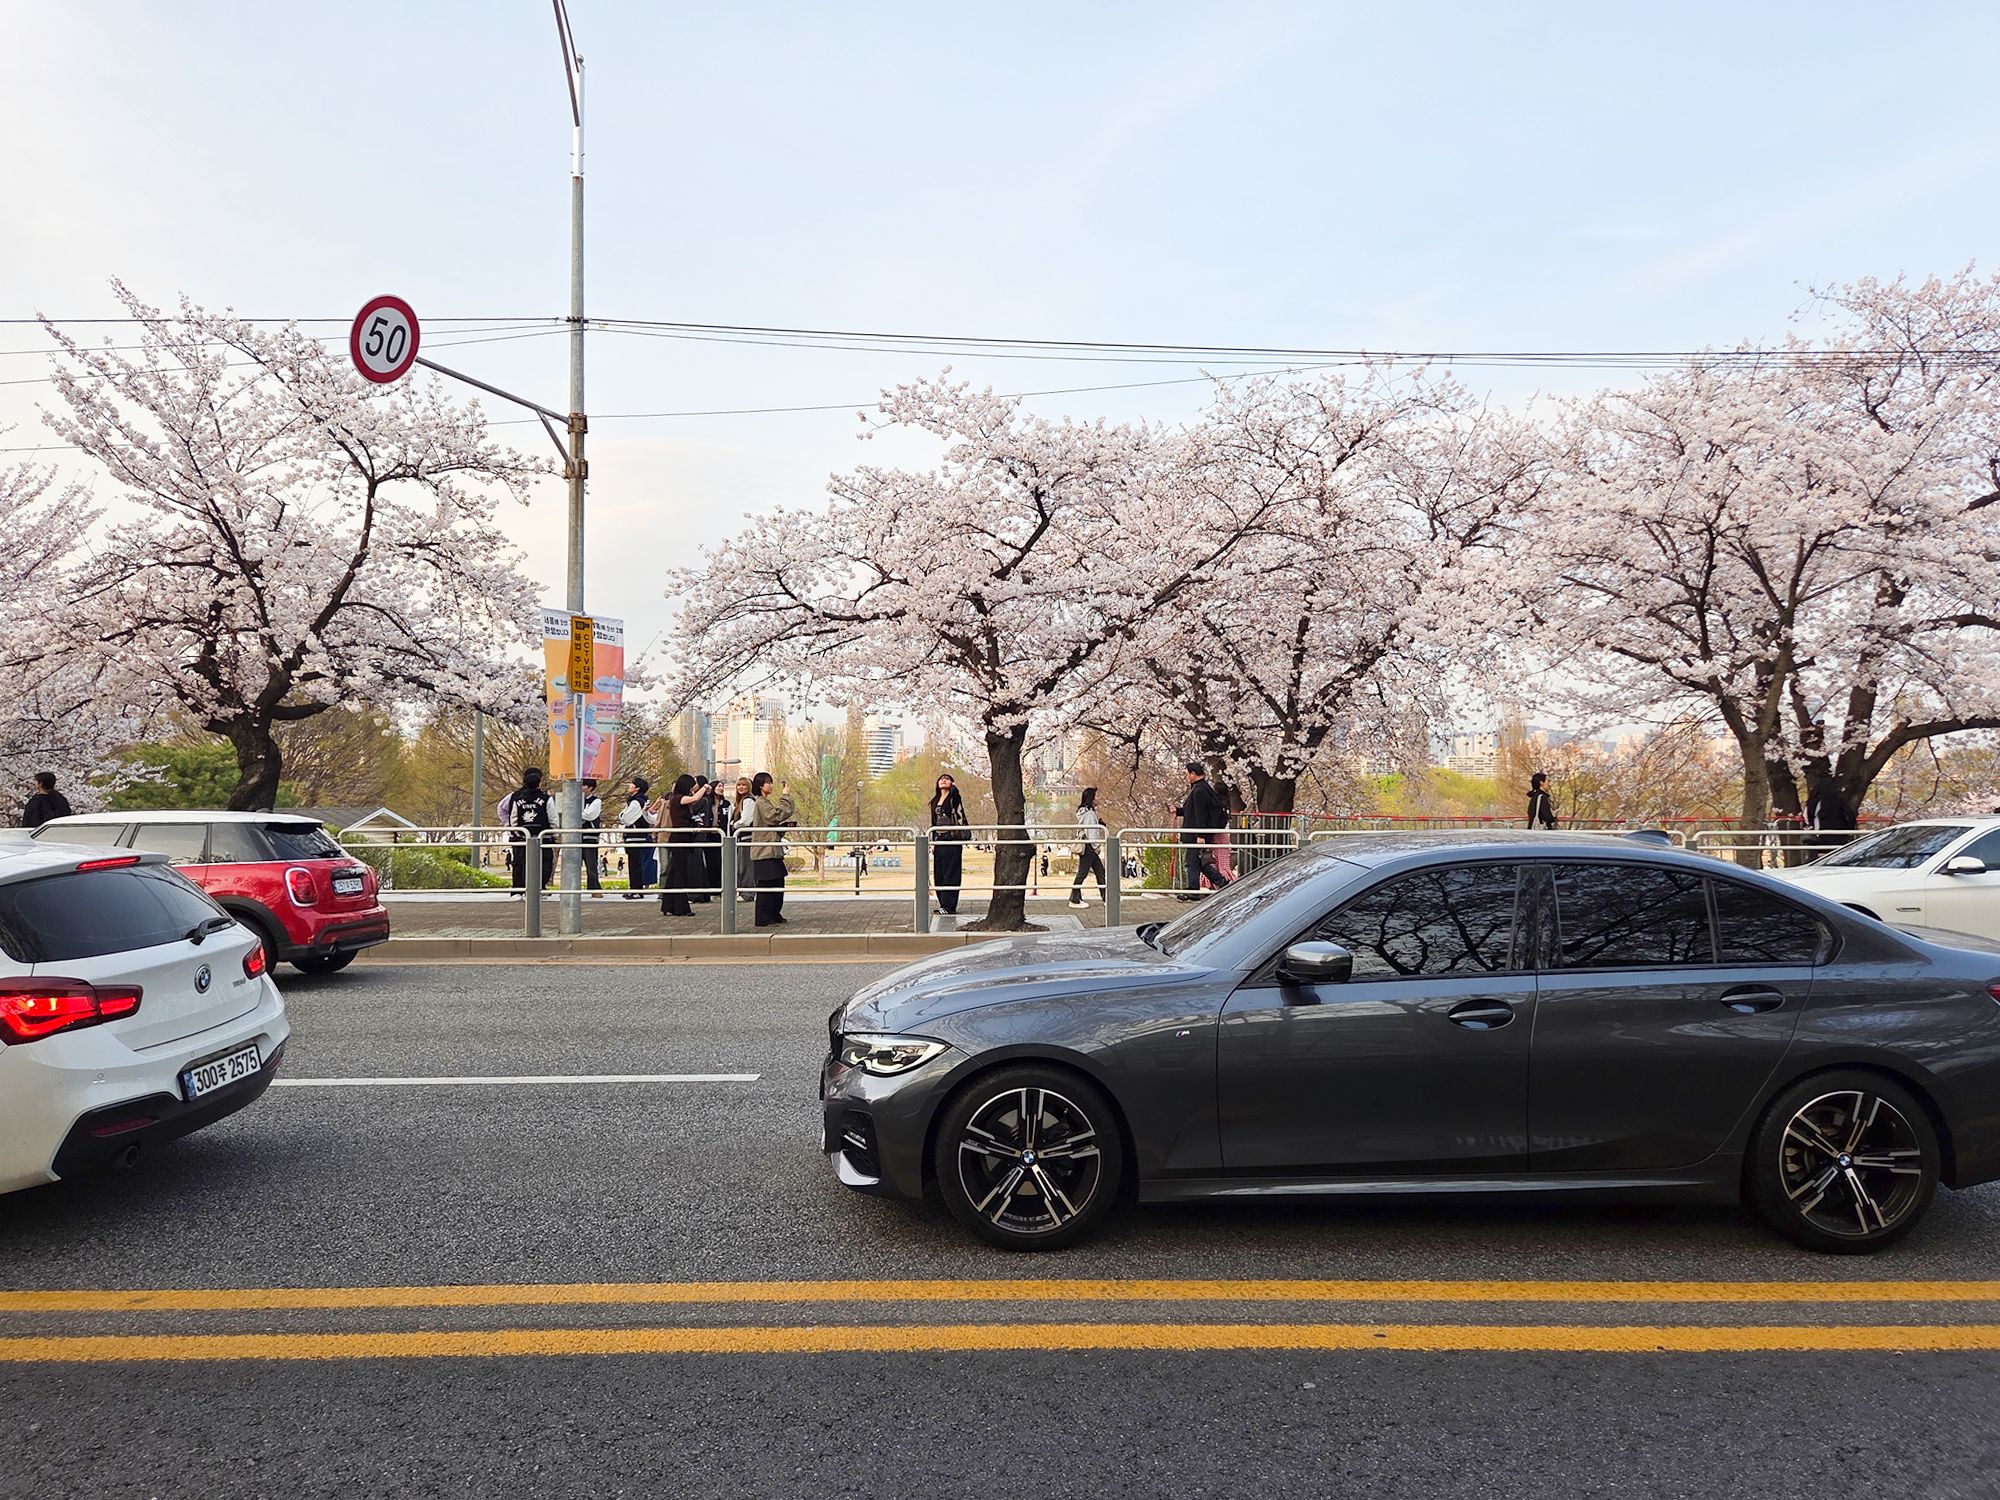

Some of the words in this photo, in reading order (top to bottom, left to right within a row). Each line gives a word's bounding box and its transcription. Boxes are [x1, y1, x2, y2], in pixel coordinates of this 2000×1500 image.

[365, 316, 406, 364] 50
[194, 1063, 227, 1093] 300주
[228, 1050, 258, 1079] 2575
